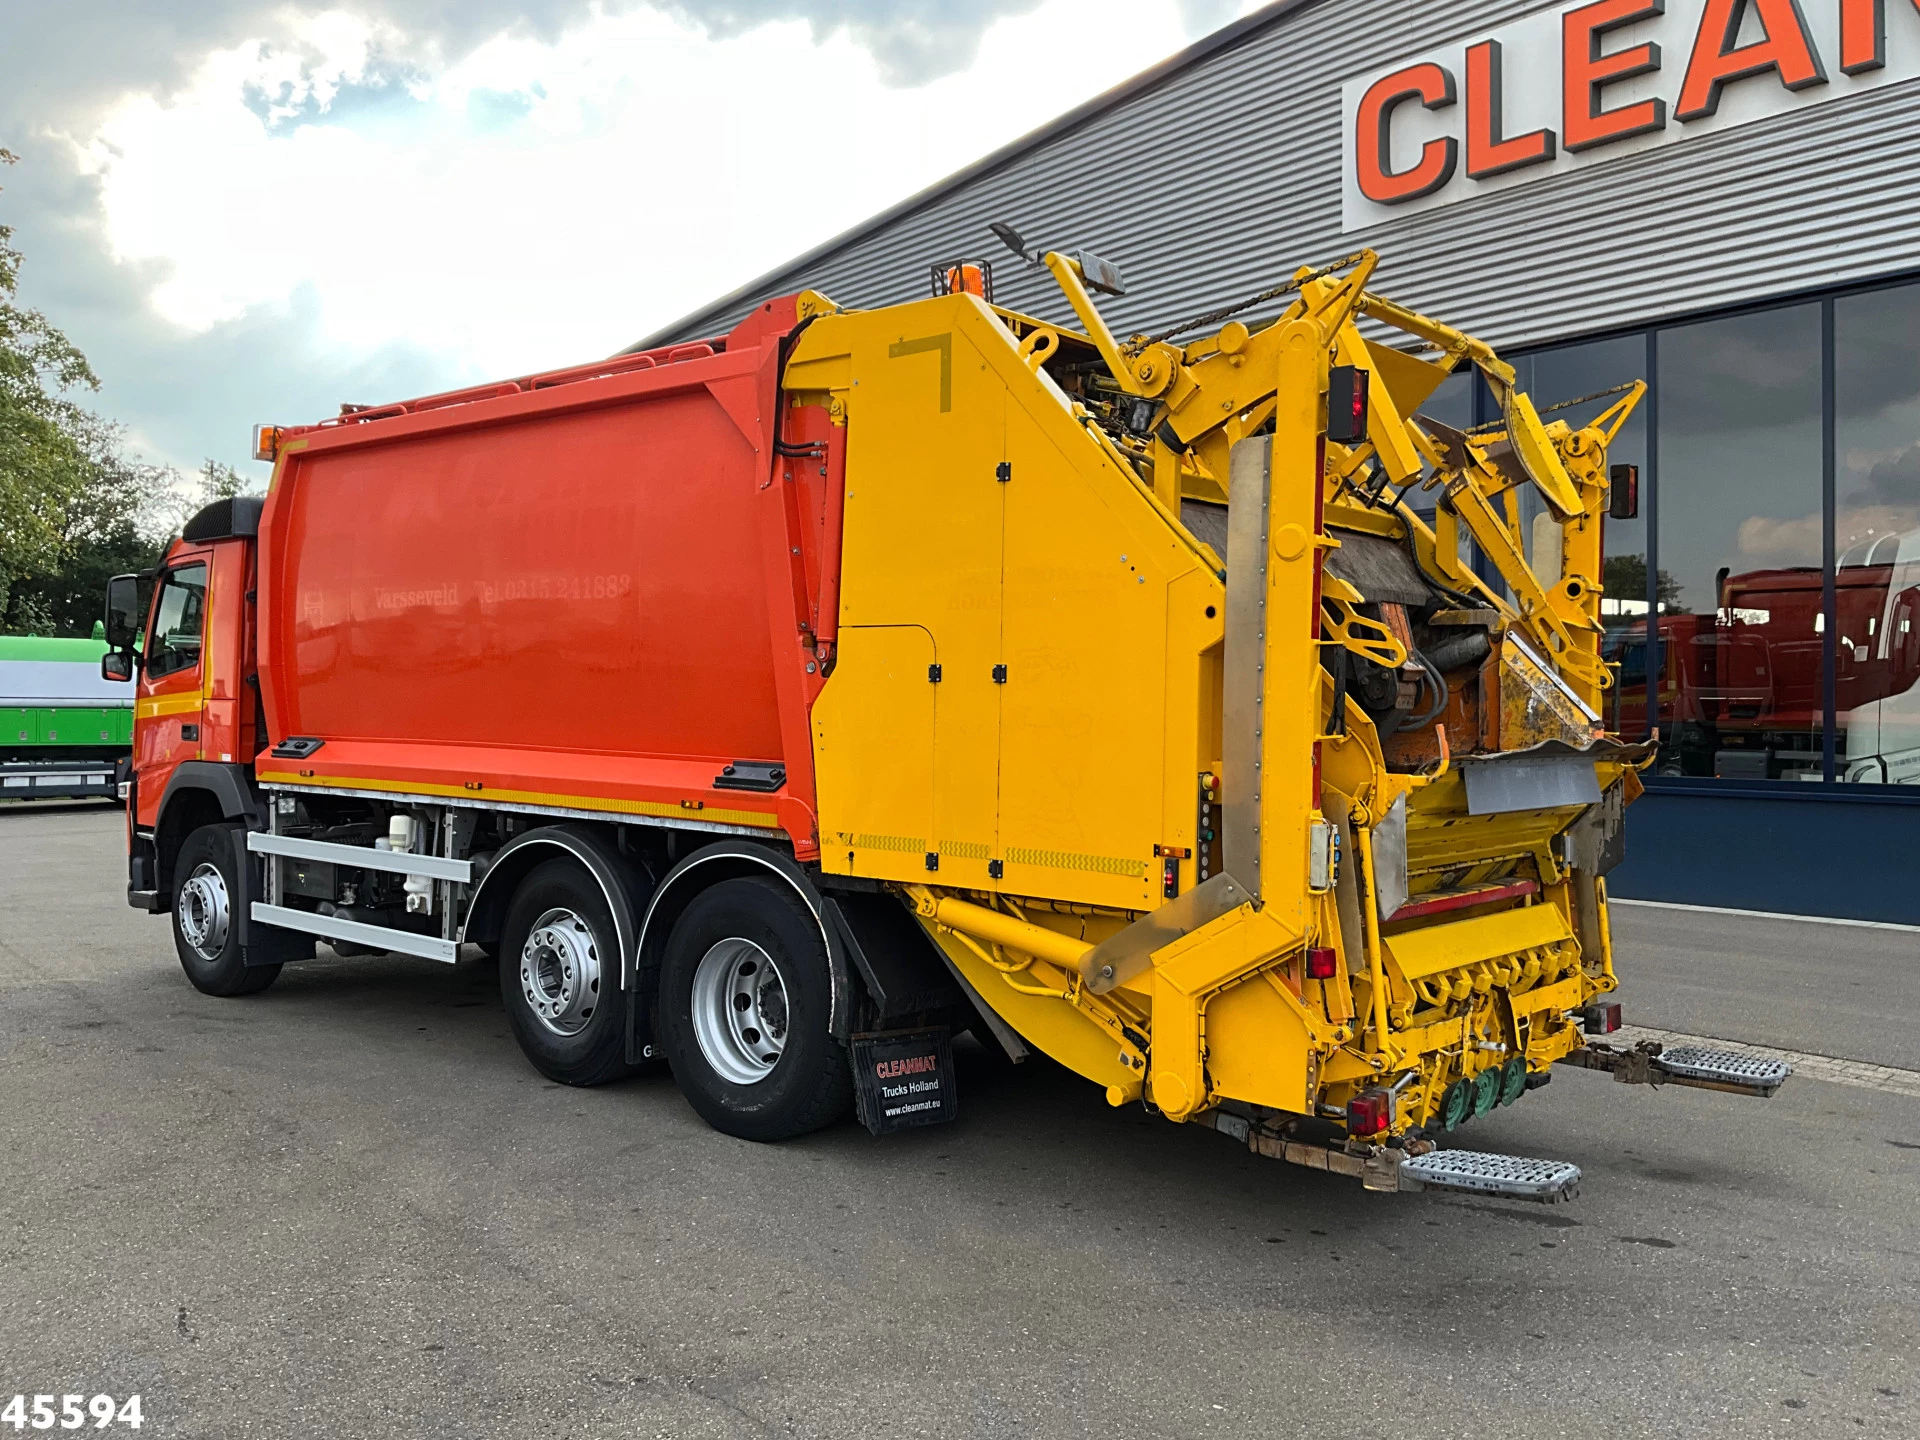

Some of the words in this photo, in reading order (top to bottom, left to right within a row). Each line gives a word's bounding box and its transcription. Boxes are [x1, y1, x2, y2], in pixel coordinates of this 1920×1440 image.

[375, 582, 459, 609] Varsseveld
[876, 1055, 936, 1079] CLEANMAT
[882, 1084, 908, 1098] Trucks
[909, 1079, 939, 1094] Holland
[885, 1099, 941, 1117] www.cleanmat.eu
